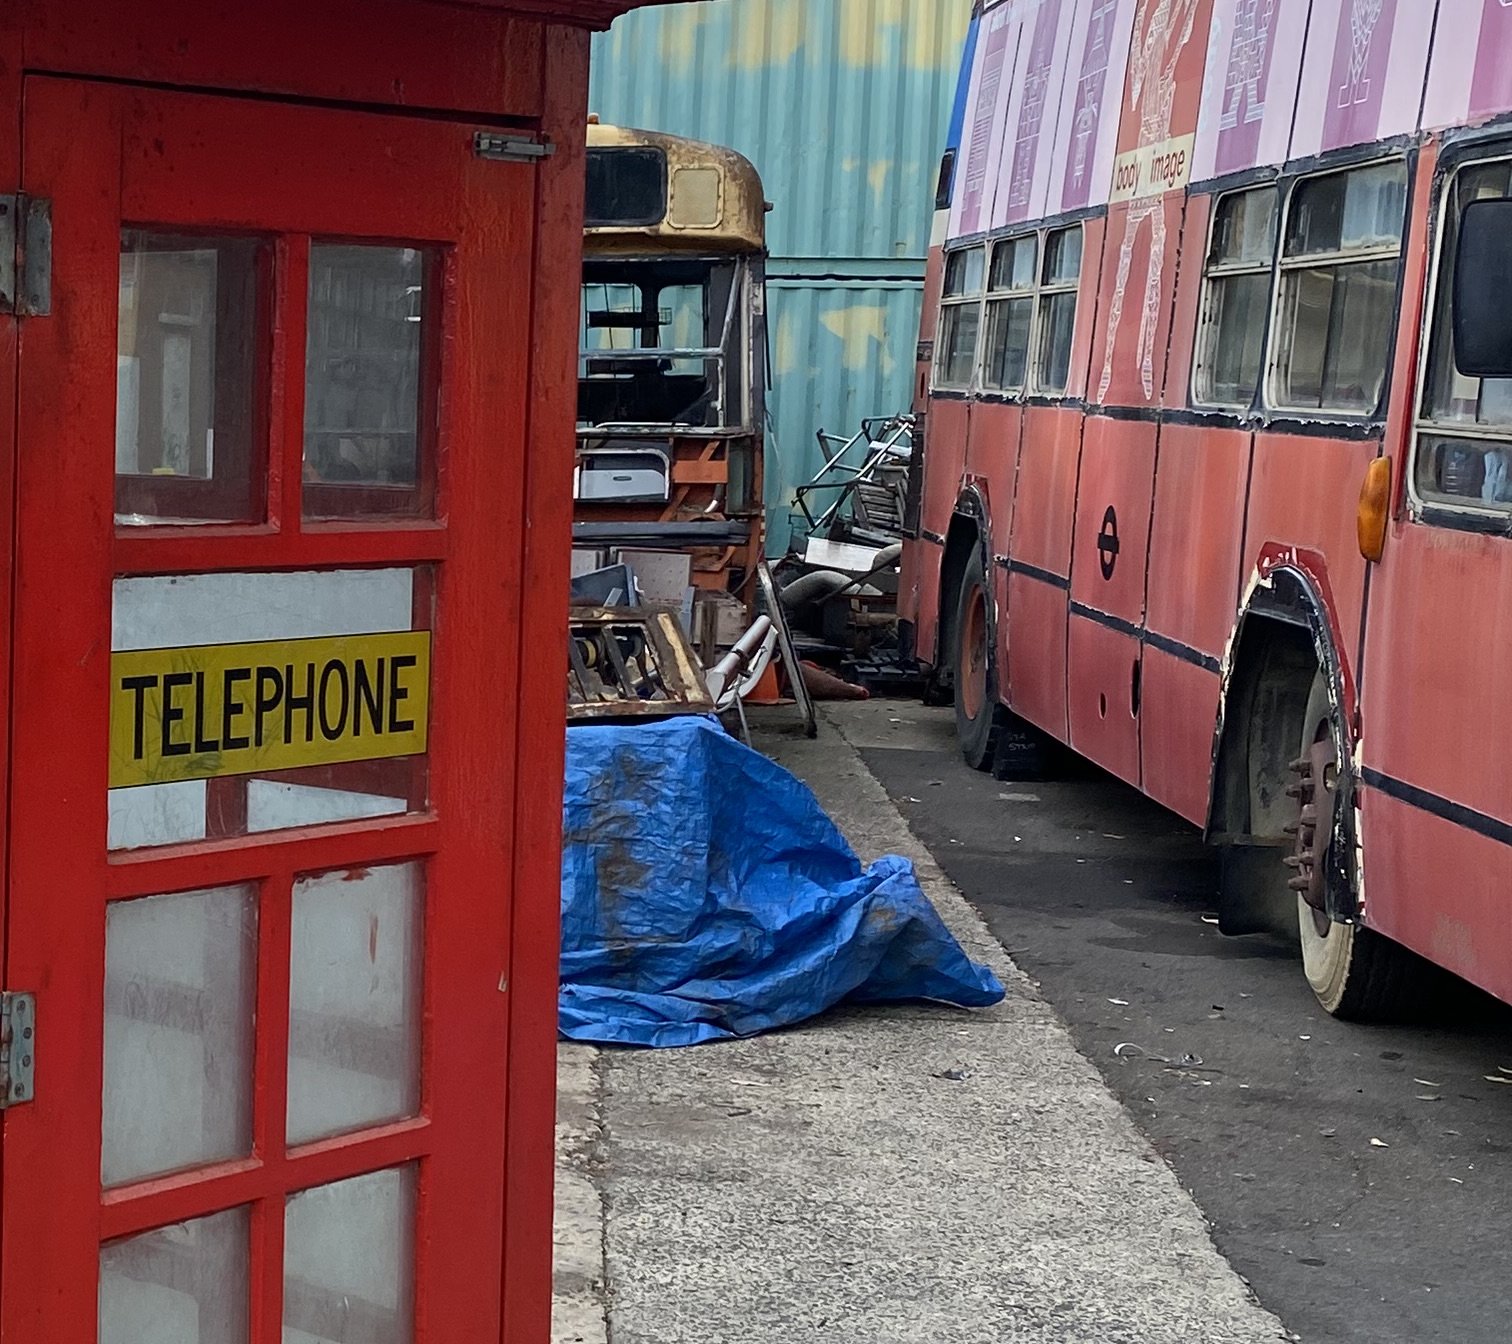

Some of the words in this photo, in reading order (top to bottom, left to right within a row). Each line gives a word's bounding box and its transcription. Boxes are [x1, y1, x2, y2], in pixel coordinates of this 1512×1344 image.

[1116, 155, 1142, 197] body
[1150, 149, 1186, 189] image
[121, 655, 417, 760] TELEPHONE
